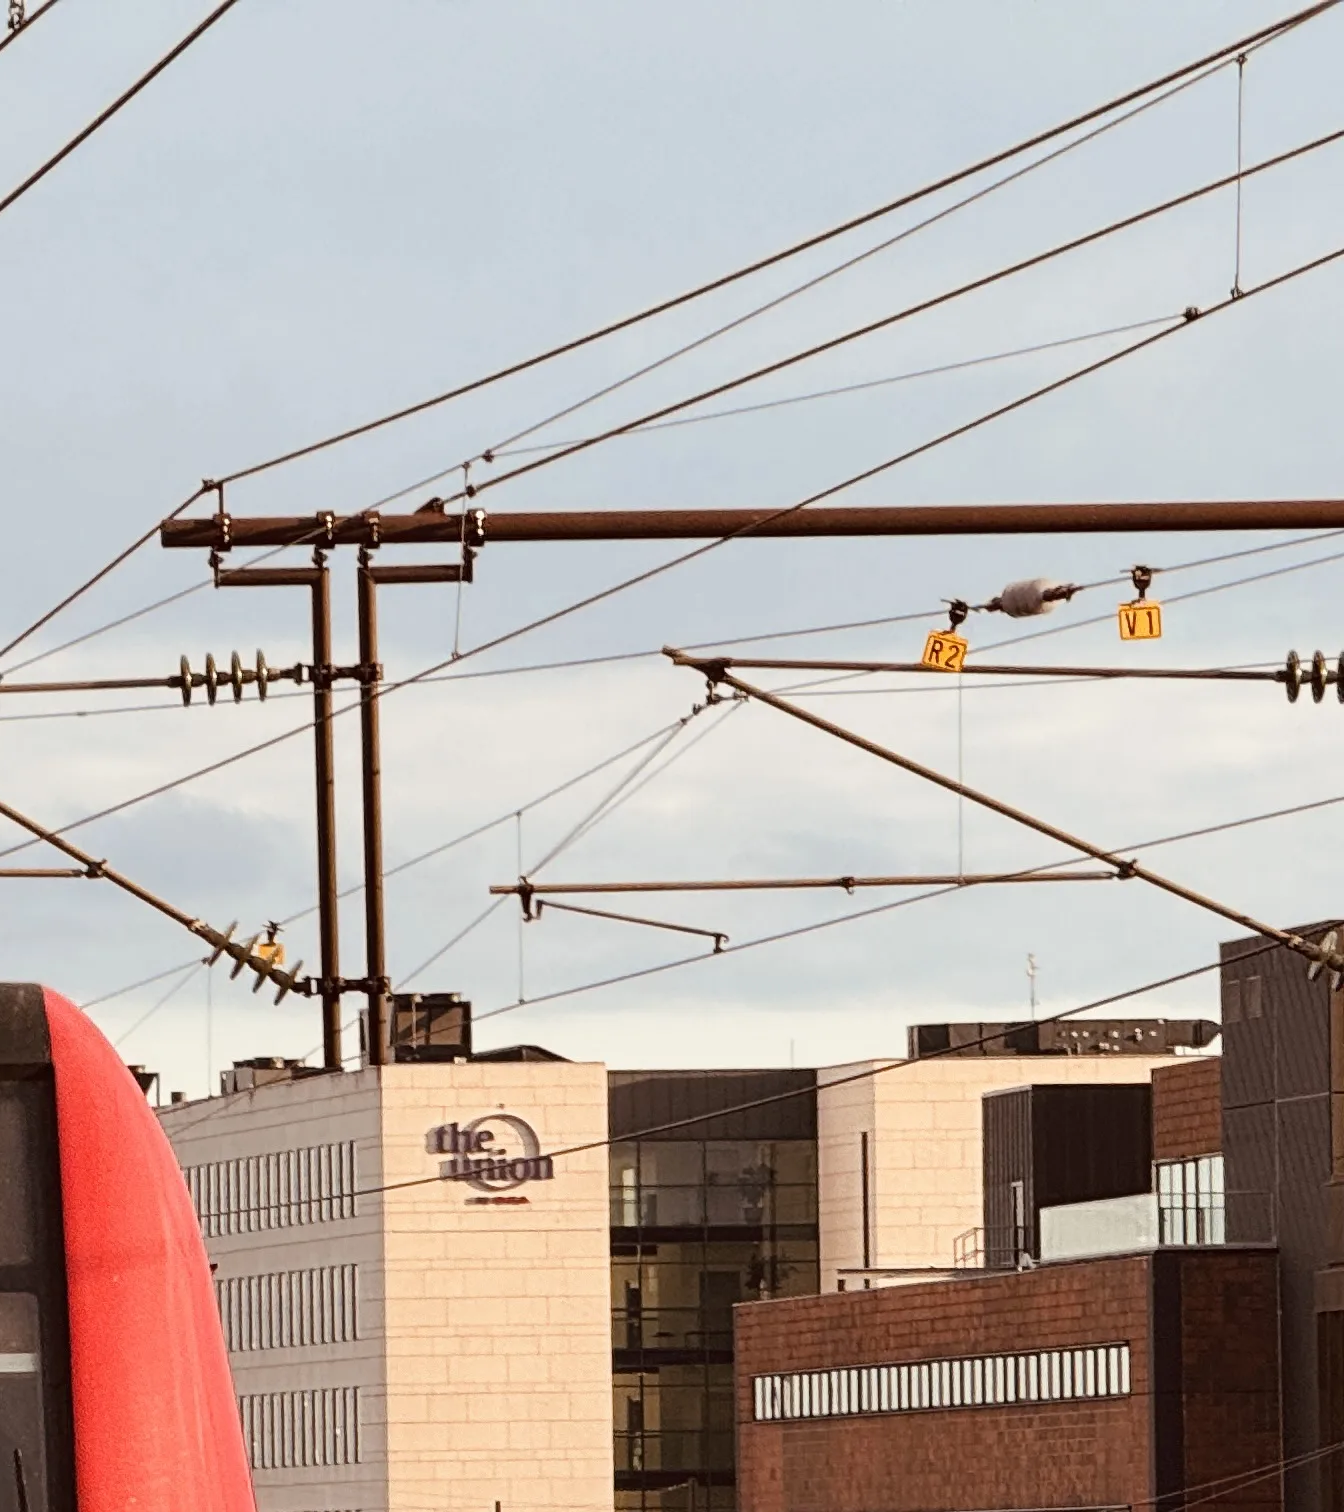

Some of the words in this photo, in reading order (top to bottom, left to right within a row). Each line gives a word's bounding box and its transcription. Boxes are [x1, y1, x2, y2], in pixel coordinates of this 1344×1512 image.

[1125, 611, 1156, 637] V1
[928, 639, 960, 670] R2
[426, 1122, 495, 1153] the
[444, 1149, 554, 1181] union
